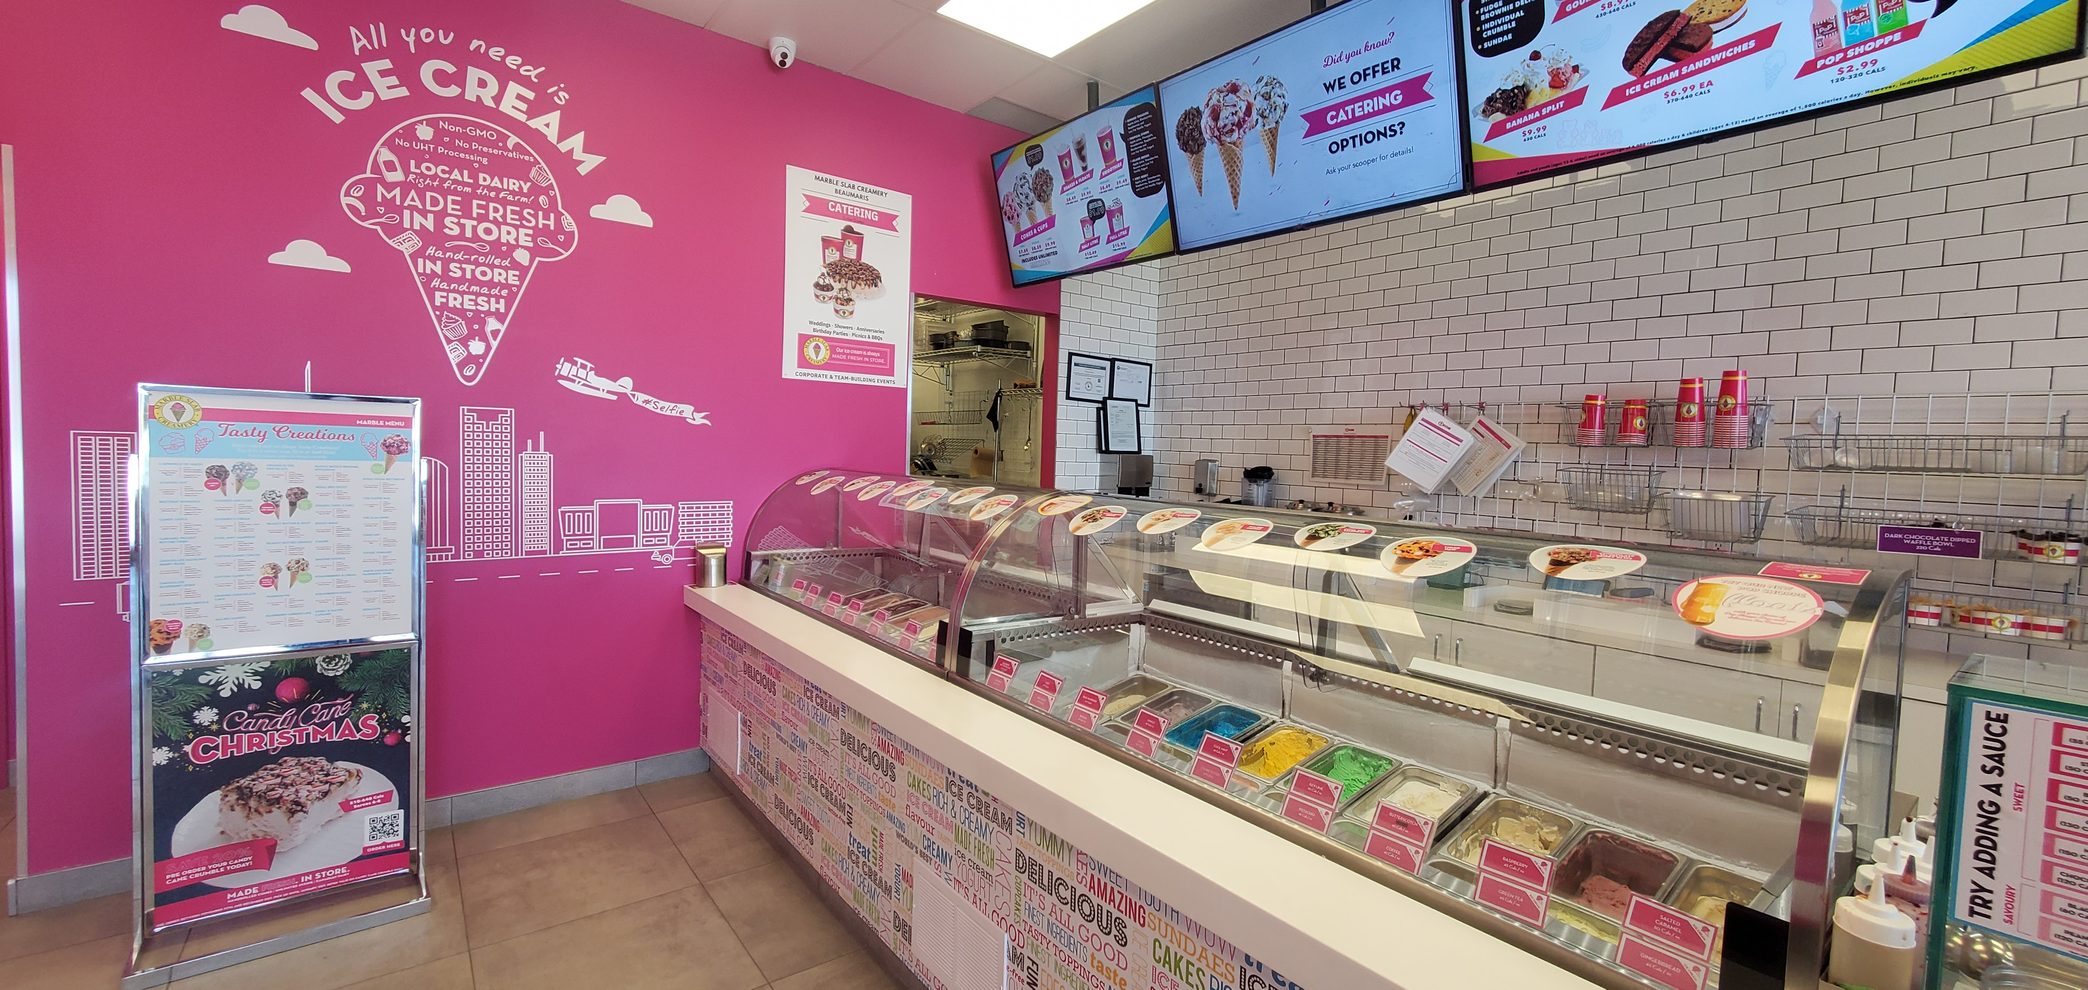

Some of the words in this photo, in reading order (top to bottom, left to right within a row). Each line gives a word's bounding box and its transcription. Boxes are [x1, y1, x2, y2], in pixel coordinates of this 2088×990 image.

[1480, 1, 1503, 14] FUDGE
[1480, 4, 1514, 21] BROWNIE
[1482, 10, 1525, 31] INDIVIDUAL
[1621, 1, 1636, 10] CALS
[1482, 21, 1516, 38] CRUMBLE
[1483, 33, 1513, 49] SUNDAE
[349, 22, 387, 55] All
[401, 27, 454, 53] you
[469, 37, 546, 83] need
[547, 83, 570, 106] is
[1322, 52, 1344, 69] Did
[1345, 47, 1362, 63] you
[1364, 31, 1396, 52] know?
[1816, 52, 1845, 69] POP
[1847, 33, 1902, 59] SHOPPE
[1323, 77, 1347, 95] WE
[1350, 57, 1401, 86] OFFER
[1625, 84, 1641, 97] ICE
[1643, 69, 1679, 91] CREAM
[1681, 39, 1756, 79] SANDWICHES
[1830, 72, 1864, 84] 120-320
[1866, 66, 1886, 80] CALS
[1837, 59, 1879, 76] $2.99
[1865, 83, 1898, 96] However,
[1899, 73, 1940, 87] individuals
[1941, 69, 1956, 79] may
[1663, 84, 1696, 99] $6.99
[1699, 79, 1714, 90] EA
[1694, 89, 1711, 97] CALS
[300, 58, 410, 125] ICE
[420, 59, 607, 177] CREAM
[1327, 90, 1403, 126] CATERING
[1506, 111, 1540, 129] BANANA
[1541, 100, 1564, 116] SPLIT
[439, 121, 497, 140] Non-GMO
[1328, 121, 1406, 155] OPTIONS?
[1522, 125, 1547, 138] $9.99
[395, 138, 410, 149] No
[413, 141, 435, 154] UHT
[437, 146, 488, 165] Processing
[455, 138, 470, 150] No
[472, 141, 535, 162] Preservatives
[1325, 167, 1337, 176] Ask
[1337, 164, 1351, 175] your
[1352, 157, 1378, 170] scooper
[1379, 154, 1389, 163] for
[1389, 146, 1415, 160] details!
[407, 174, 440, 191] Right
[443, 179, 472, 194] from
[476, 186, 495, 199] the
[499, 190, 534, 204] Farm!
[410, 159, 474, 184] LOCAL
[479, 173, 532, 194] DAIRY
[814, 175, 839, 187] MARBLE
[841, 180, 856, 190] SLAB
[857, 184, 888, 198] CREAMERY
[377, 183, 462, 214] MADE
[472, 201, 555, 230] FRESH
[834, 189, 870, 202] BEAUMARIS
[829, 202, 879, 221] CATERING
[403, 210, 435, 232] IN
[443, 218, 534, 247] STORE
[418, 258, 442, 276] IN
[449, 263, 520, 285] STORE
[426, 246, 512, 267] Hand-rolled
[431, 278, 508, 297] Handmade
[435, 291, 505, 312] FRESH
[809, 320, 831, 328] Weddings
[856, 326, 885, 334] Anniversaries
[795, 371, 828, 380] CORPORATE
[834, 374, 875, 384] TEAM-BUILDING
[642, 399, 685, 415] #Selfie
[218, 423, 268, 443] Tasty
[272, 424, 356, 442] Creations
[357, 418, 384, 427] MARBLE
[1904, 534, 1949, 542] CHOCOLATE
[743, 660, 777, 697] DELICIOUS
[223, 708, 297, 733] Candy
[299, 699, 352, 725] Cane
[188, 714, 380, 764] CHRISTMAS
[877, 735, 905, 767] AMAZING
[1981, 710, 2010, 777] SAUCE
[840, 728, 896, 782] DELICIOUS
[1979, 783, 2003, 797] A
[2013, 782, 2025, 812] SWEET
[774, 793, 815, 846] DELICIOUS
[905, 803, 935, 836] flavour
[945, 776, 964, 803] ICE
[966, 791, 1013, 835] CREAM
[848, 831, 872, 863] treat
[922, 834, 953, 868] CREAMY
[954, 821, 972, 851] MADE
[973, 839, 996, 872] FRESH
[1973, 799, 2001, 881] ADDING
[166, 872, 180, 880] PRE
[182, 867, 207, 877] ORDER
[208, 862, 228, 871] YOUR
[229, 856, 253, 867] CANDY
[166, 876, 188, 885] CANE
[190, 867, 225, 879] CRUMBLE
[227, 862, 253, 872] TODAY!
[1503, 857, 1528, 869] RASPBERRY
[227, 887, 259, 900] MADE
[301, 872, 312, 882] IN
[315, 867, 350, 880] STORE.
[1015, 847, 1128, 947] DELICIOUS
[1013, 874, 1023, 925] CUPCAKES
[1088, 873, 1146, 928] AMAZING
[1968, 879, 1994, 921] TRY
[2003, 885, 2016, 925] SAVOURY
[1022, 882, 1046, 911] IT'S
[1049, 901, 1075, 934] ALL
[1078, 923, 1129, 972] GOOD
[1655, 919, 1682, 934] CARAMEL
[1660, 915, 1681, 926] SALTED
[1022, 919, 1052, 947] TASTY
[1053, 942, 1106, 990] TOPPINGS
[1147, 911, 1237, 984] SUNDAES
[1640, 952, 1681, 973] GINGERBREAD
[1089, 951, 1128, 989] taste
